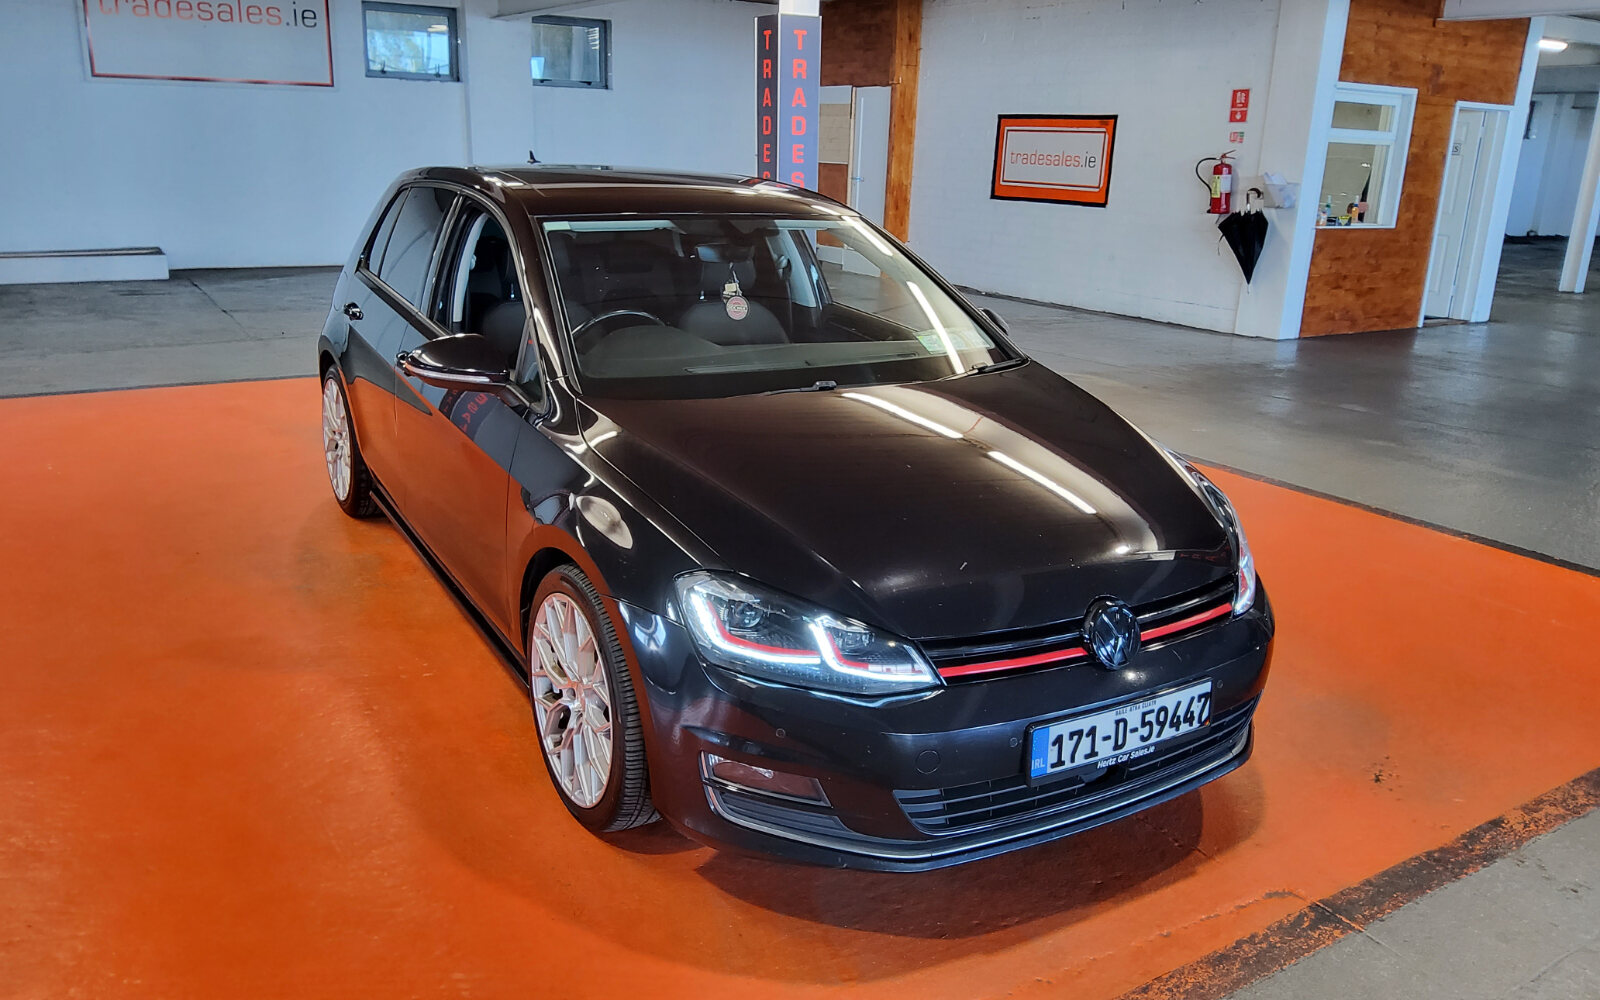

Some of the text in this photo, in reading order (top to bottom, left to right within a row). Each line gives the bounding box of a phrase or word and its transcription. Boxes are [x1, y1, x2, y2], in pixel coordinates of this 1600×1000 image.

[1010, 149, 1097, 168] tradesales.ie
[1050, 692, 1211, 769] 171-D-59447
[1031, 758, 1046, 770] IRL
[1097, 757, 1116, 769] Hertz
[1118, 753, 1129, 763] Car
